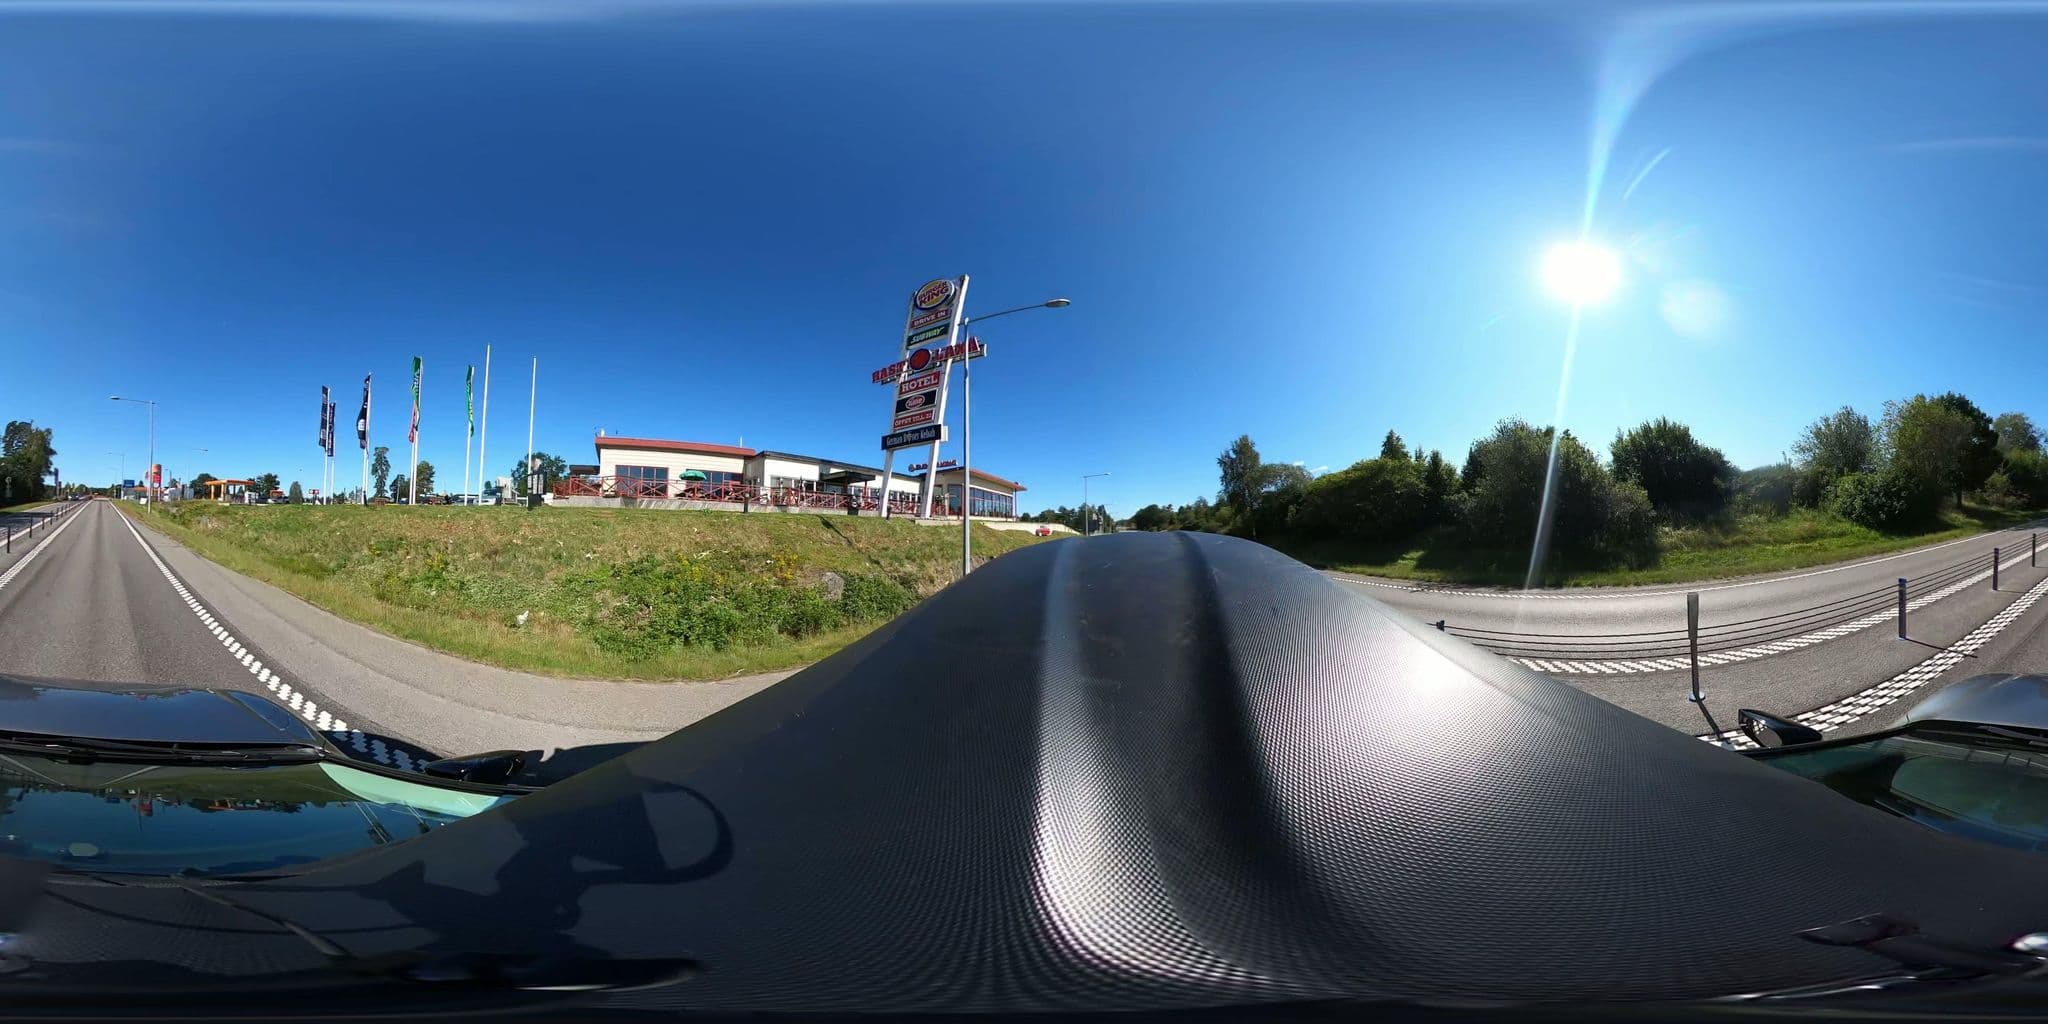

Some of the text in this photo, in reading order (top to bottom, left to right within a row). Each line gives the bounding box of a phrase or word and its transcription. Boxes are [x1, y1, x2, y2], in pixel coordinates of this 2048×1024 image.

[918, 281, 947, 298] BURGER
[919, 287, 949, 305] KING
[914, 310, 946, 326] DRIVE IN
[911, 326, 945, 345] SUBWAY
[901, 374, 938, 392] HOTEL
